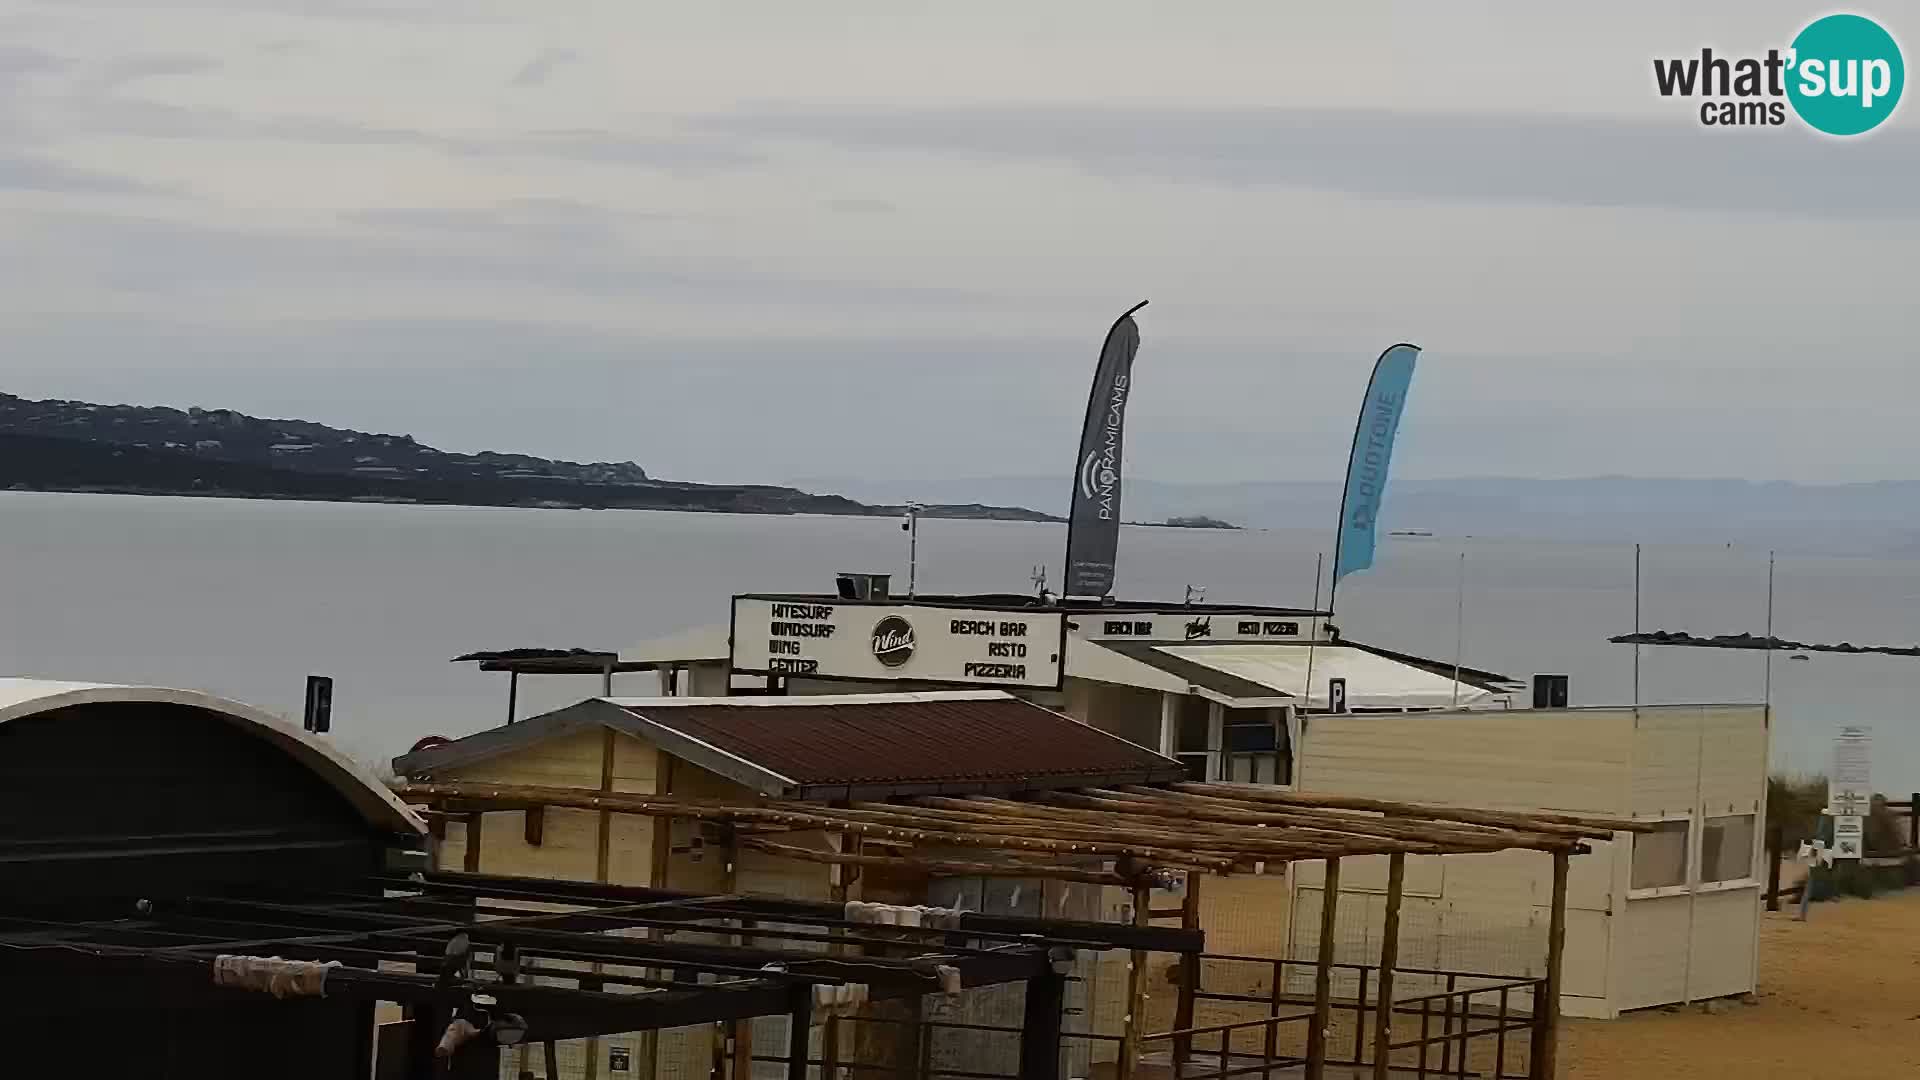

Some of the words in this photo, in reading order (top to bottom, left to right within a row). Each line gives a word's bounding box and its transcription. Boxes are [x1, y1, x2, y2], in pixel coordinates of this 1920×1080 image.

[1099, 374, 1128, 521] PANORAMICAMS
[771, 603, 834, 620] KITESURF
[770, 621, 836, 638] WINDSURF
[950, 619, 995, 636] BEACH
[1000, 622, 1027, 637] BAR
[768, 639, 801, 655] WING
[873, 628, 914, 652] Wind
[988, 642, 1027, 657] RISTO
[768, 658, 818, 673] CENTER
[964, 662, 1026, 680] PIZZERIA
